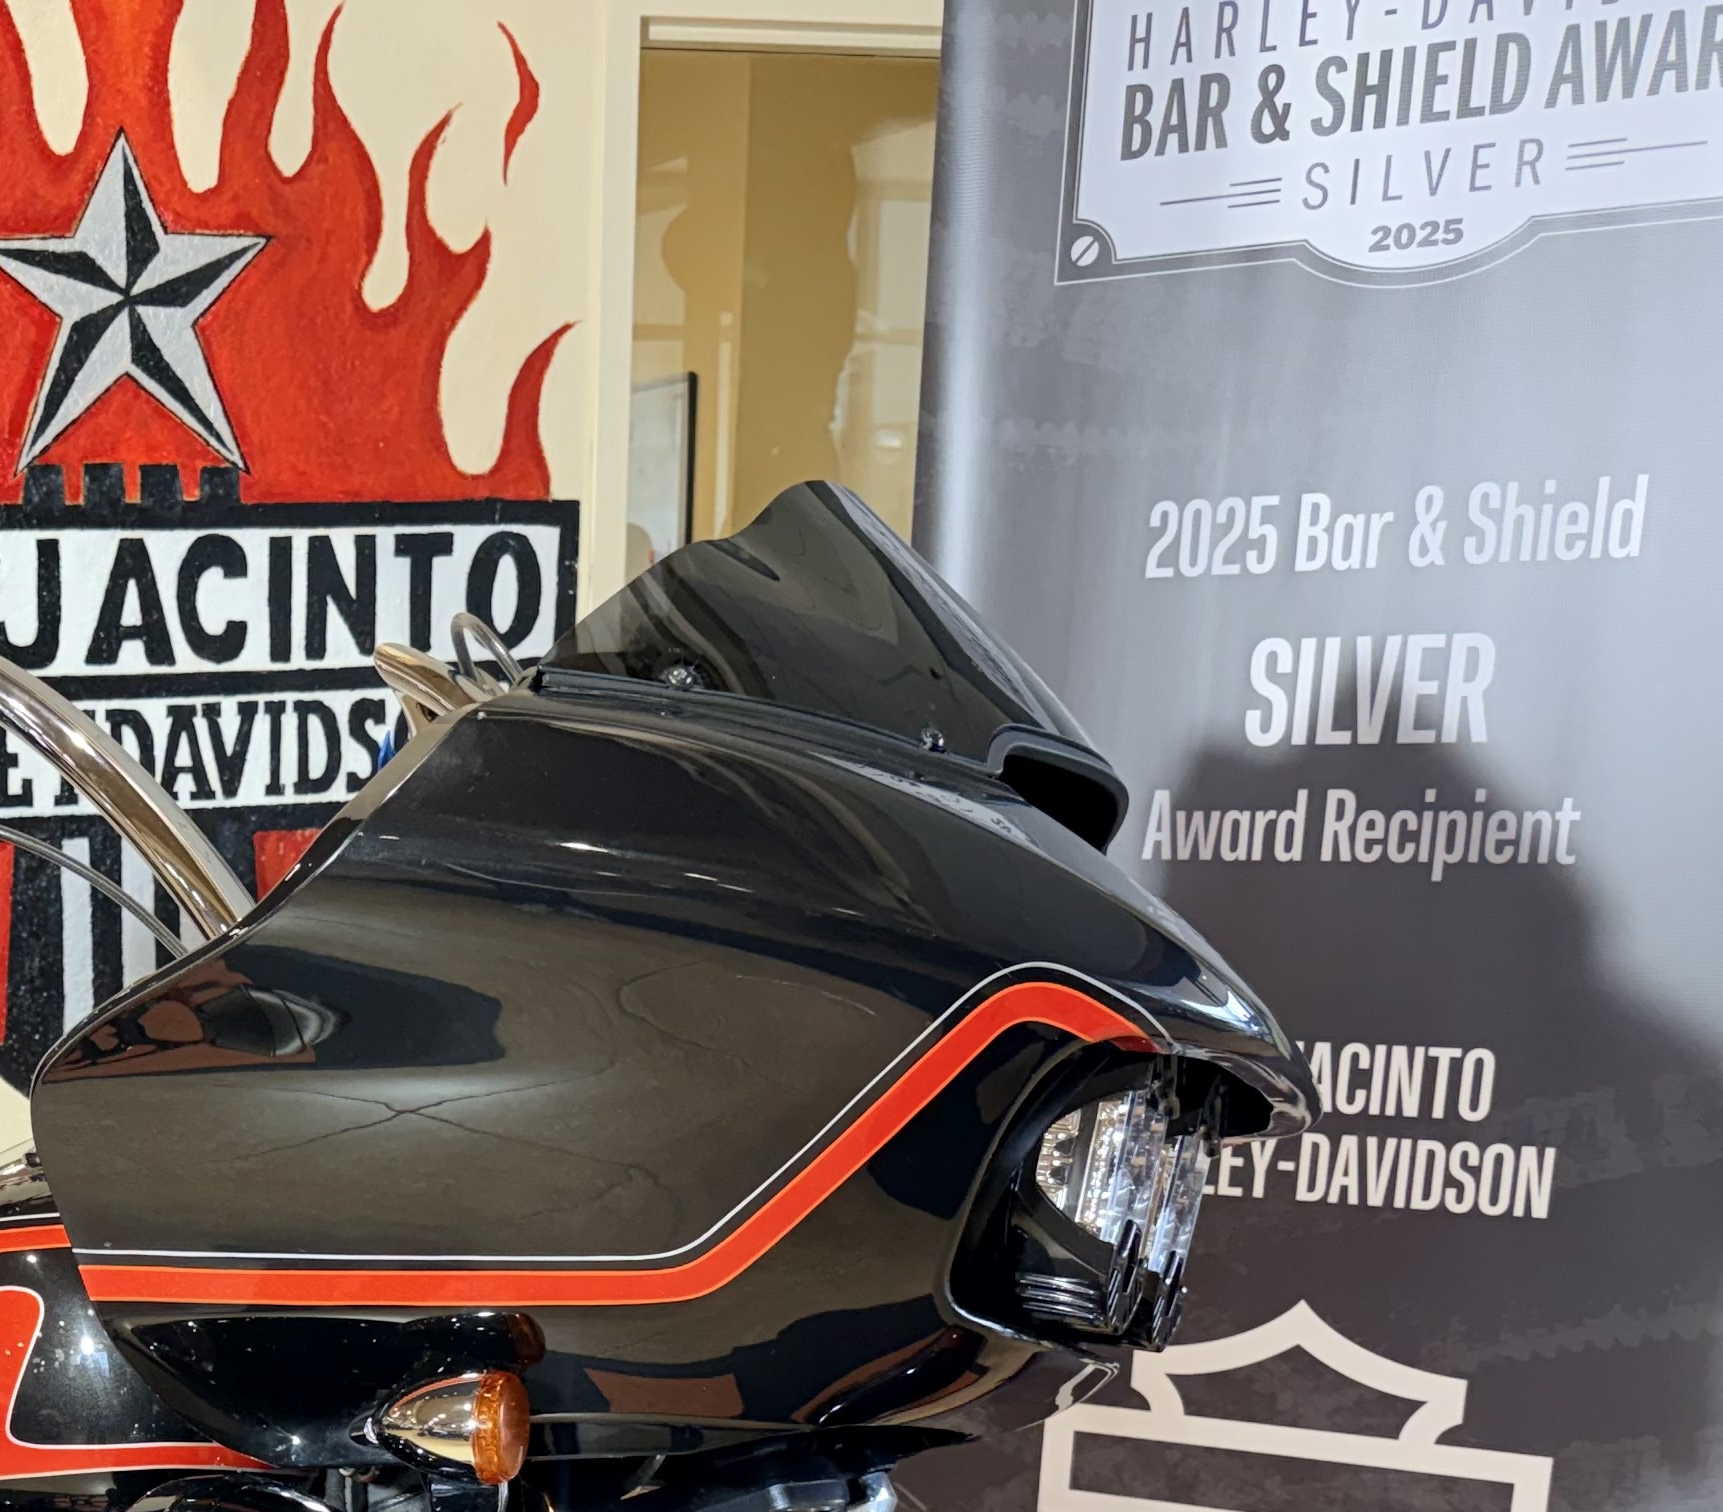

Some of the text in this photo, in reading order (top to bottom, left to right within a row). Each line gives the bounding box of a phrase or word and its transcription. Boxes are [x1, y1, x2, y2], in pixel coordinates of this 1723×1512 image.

[1127, 0, 1621, 71] HARLEY-
[1120, 72, 1231, 161] BAR
[1250, 63, 1292, 144] &
[1310, 32, 1532, 137] SHIELD
[1302, 137, 1545, 210] SILVER
[1368, 217, 1464, 253] 2025
[1144, 474, 1650, 579] 2025 Bar & Shield
[1244, 632, 1497, 747] SILVER
[1141, 787, 1582, 882] Award Recipient
[1296, 1040, 1496, 1122] ACINTO
